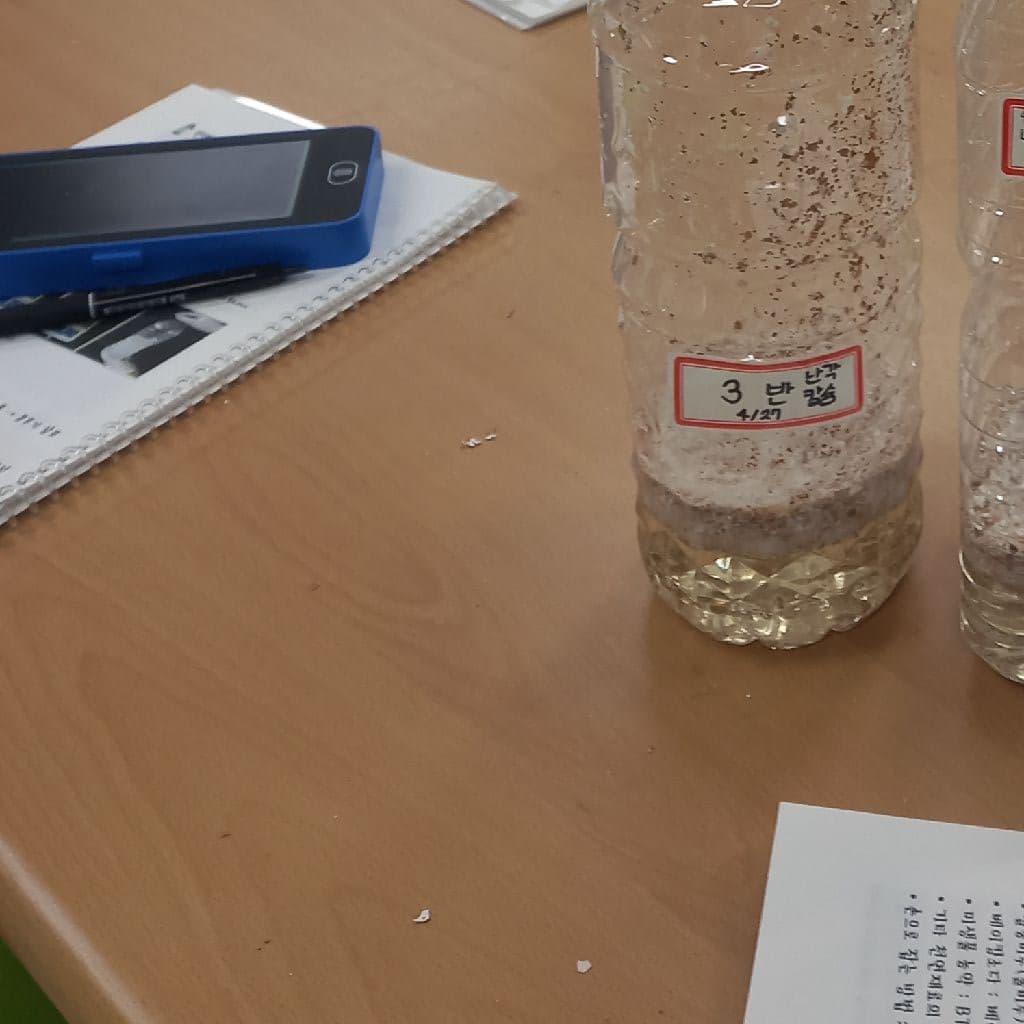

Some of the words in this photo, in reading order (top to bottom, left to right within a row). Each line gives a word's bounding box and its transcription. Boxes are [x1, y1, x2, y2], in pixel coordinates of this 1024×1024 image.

[720, 378, 743, 405] 3
[766, 382, 795, 406] 반
[736, 408, 782, 422] 4/27
